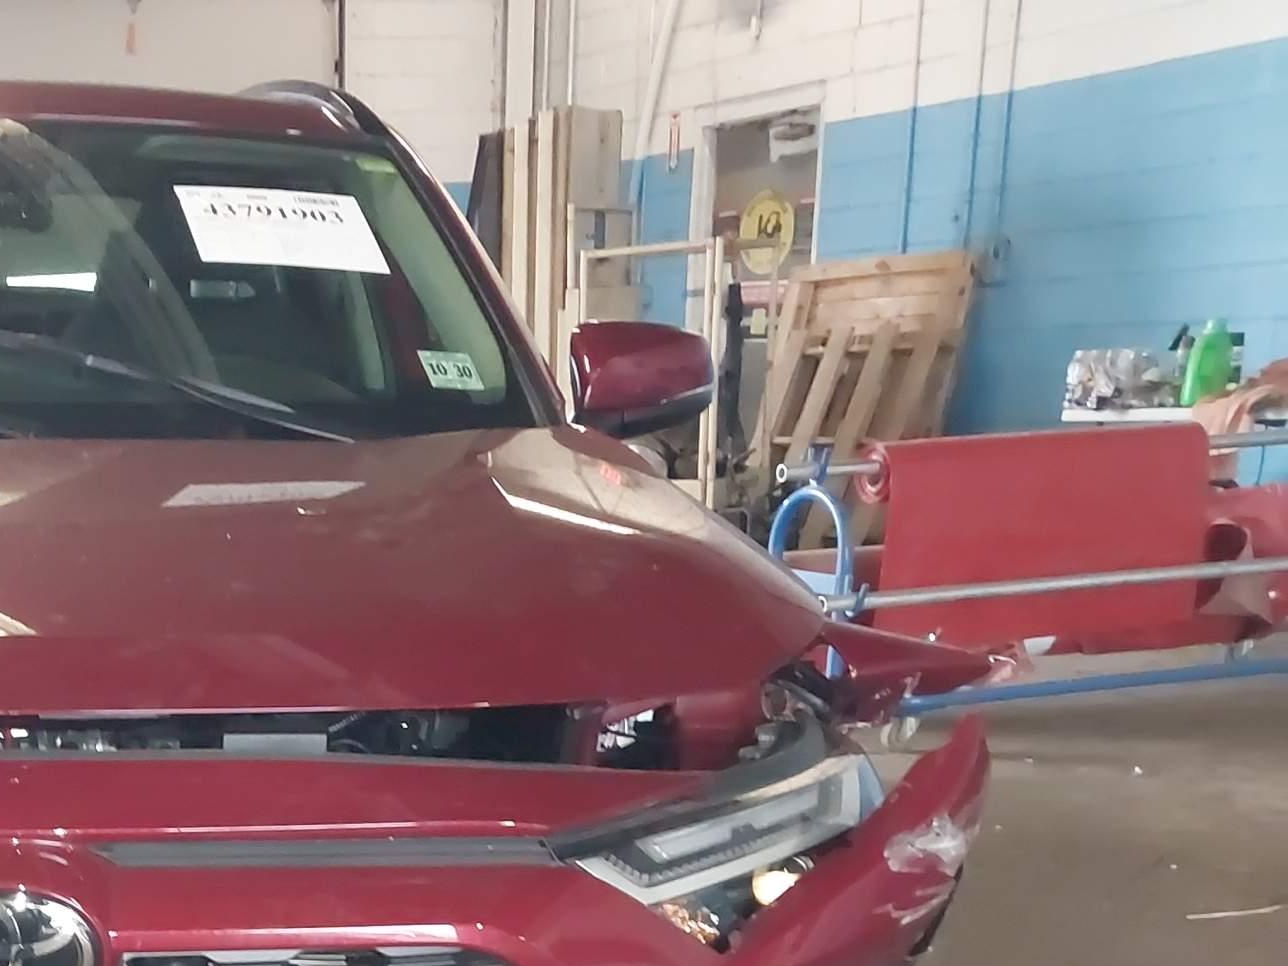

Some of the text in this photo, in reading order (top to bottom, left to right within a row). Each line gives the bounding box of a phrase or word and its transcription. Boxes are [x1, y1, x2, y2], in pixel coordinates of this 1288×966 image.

[203, 202, 344, 224] 43791903
[428, 361, 473, 378] 10 30
